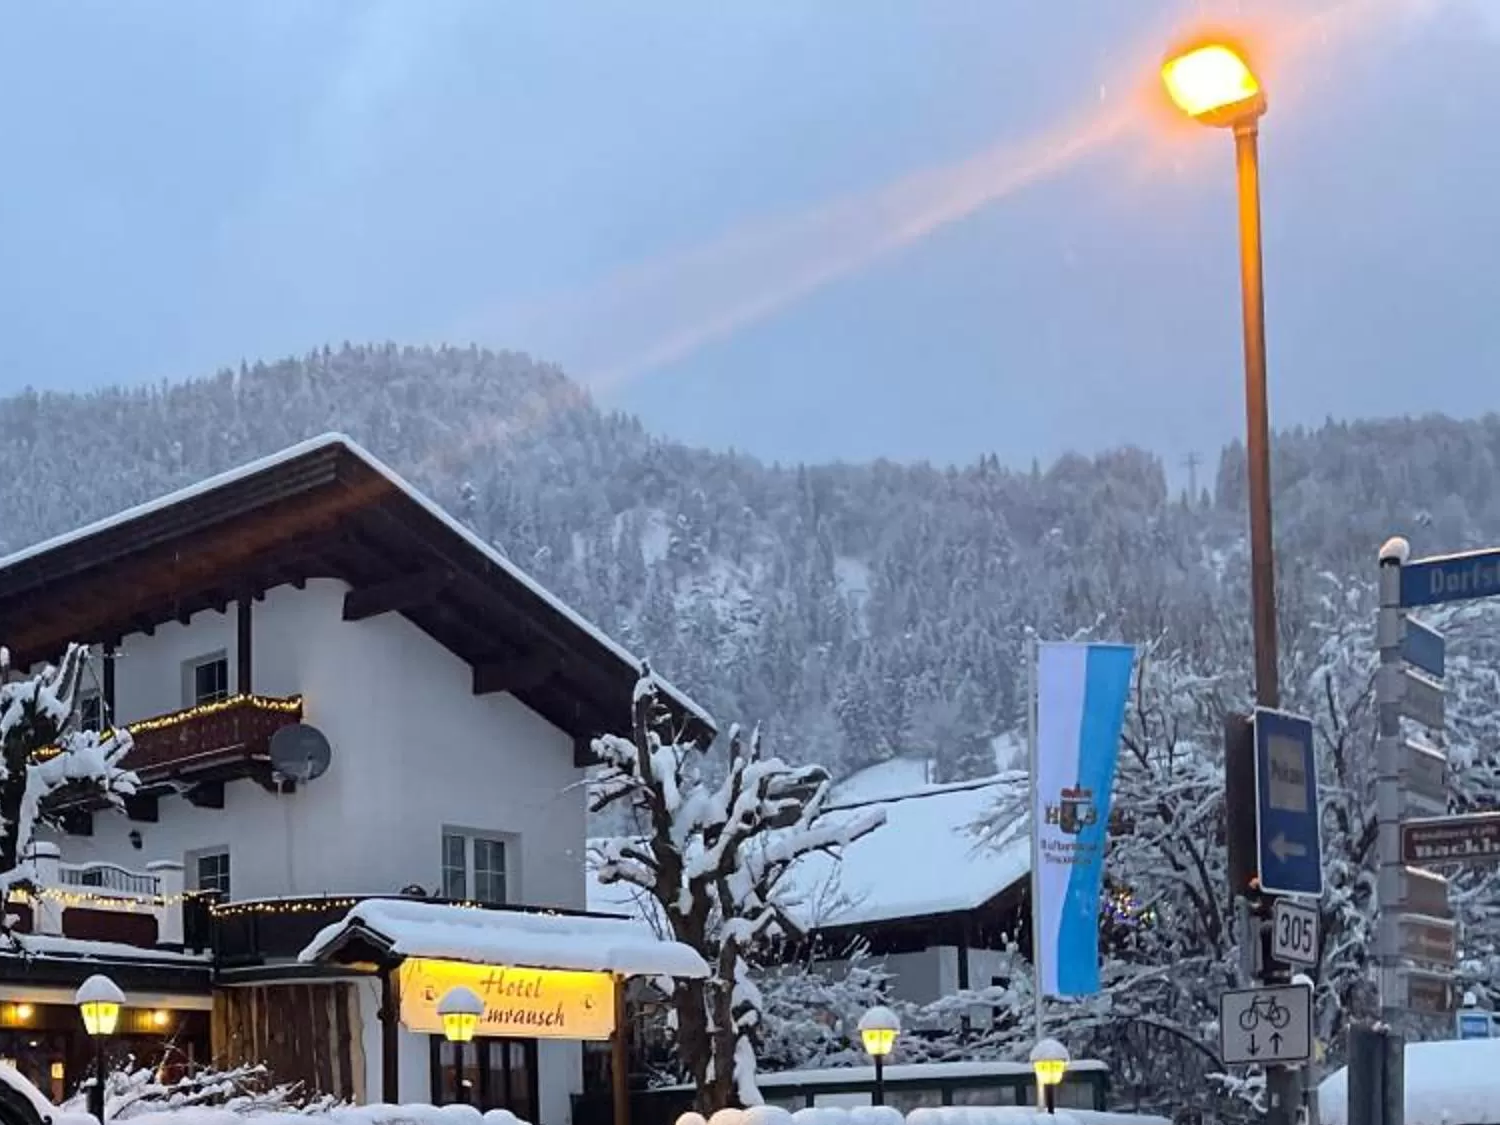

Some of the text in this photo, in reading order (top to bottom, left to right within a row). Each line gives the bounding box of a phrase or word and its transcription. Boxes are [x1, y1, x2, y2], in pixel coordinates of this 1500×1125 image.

[1280, 913, 1312, 953] 305
[479, 970, 543, 998] Hotel
[480, 1001, 565, 1027] mrausch
